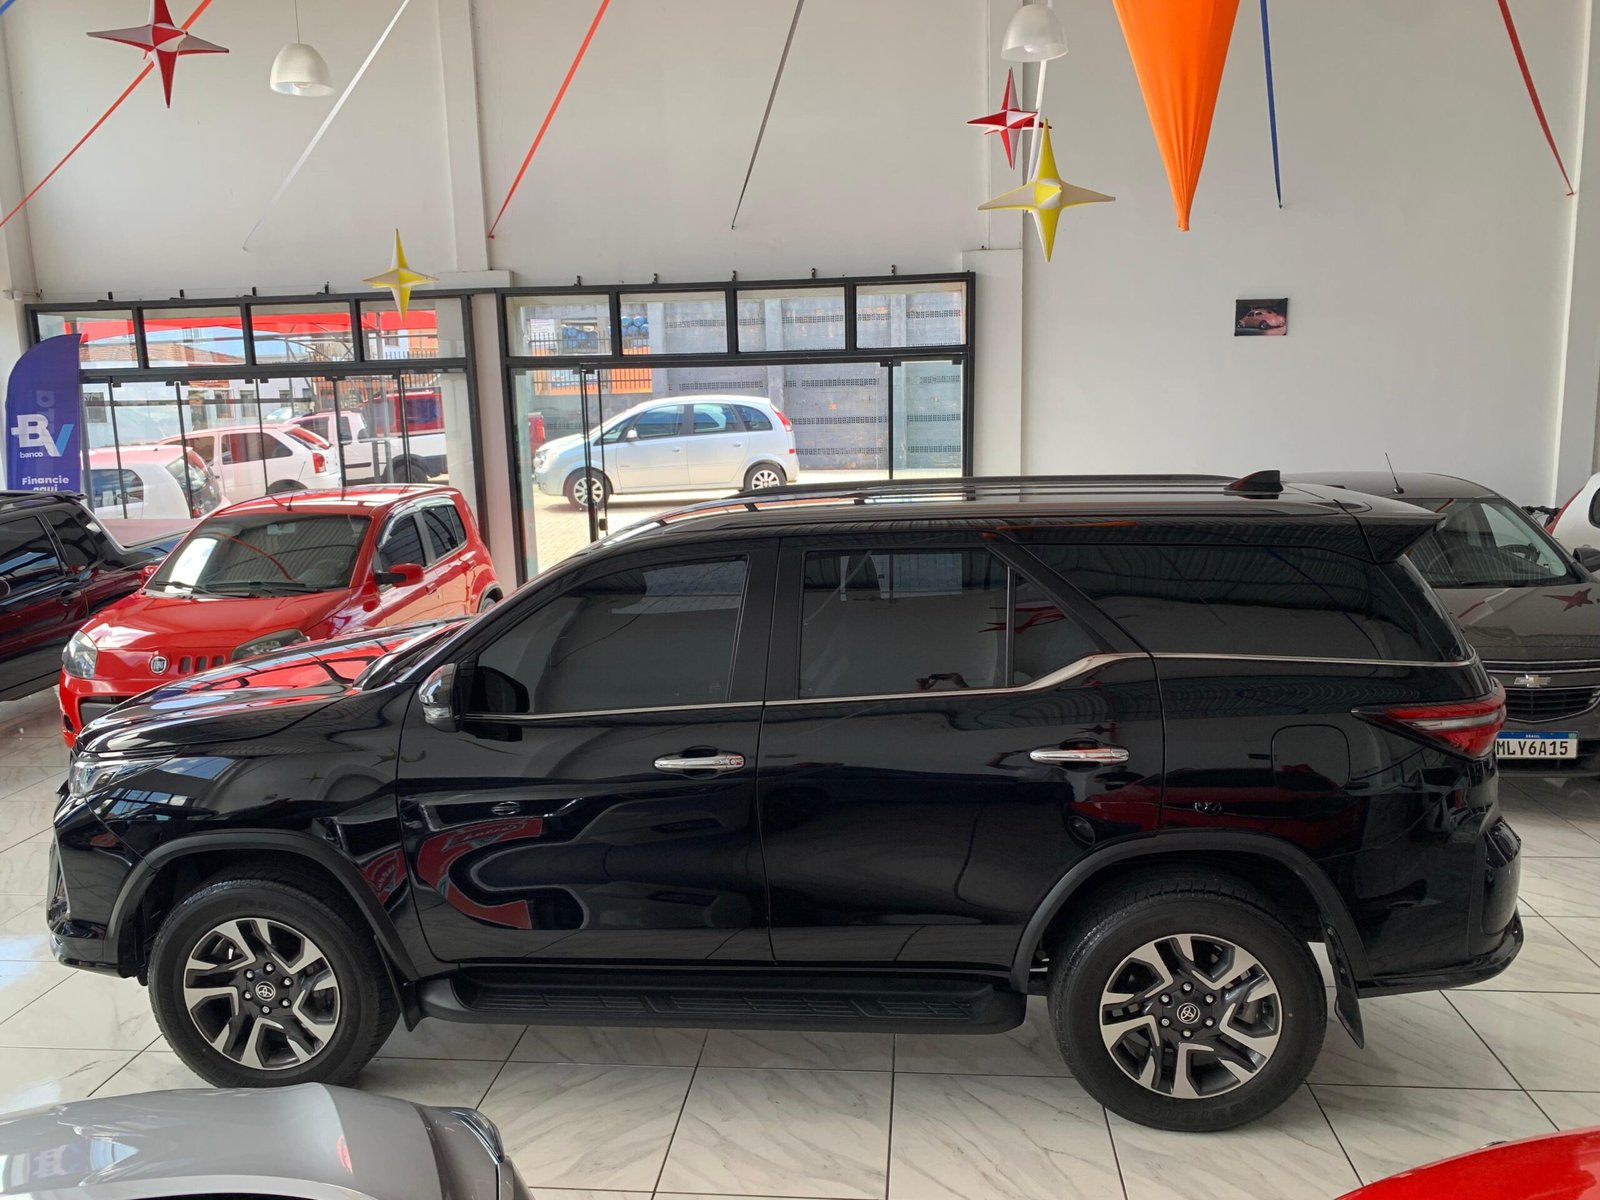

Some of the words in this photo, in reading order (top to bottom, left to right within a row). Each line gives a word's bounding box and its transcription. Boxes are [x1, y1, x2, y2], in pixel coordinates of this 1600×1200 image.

[11, 414, 74, 457] BV
[22, 475, 69, 485] Financie
[1496, 741, 1568, 755] MLY6A15
